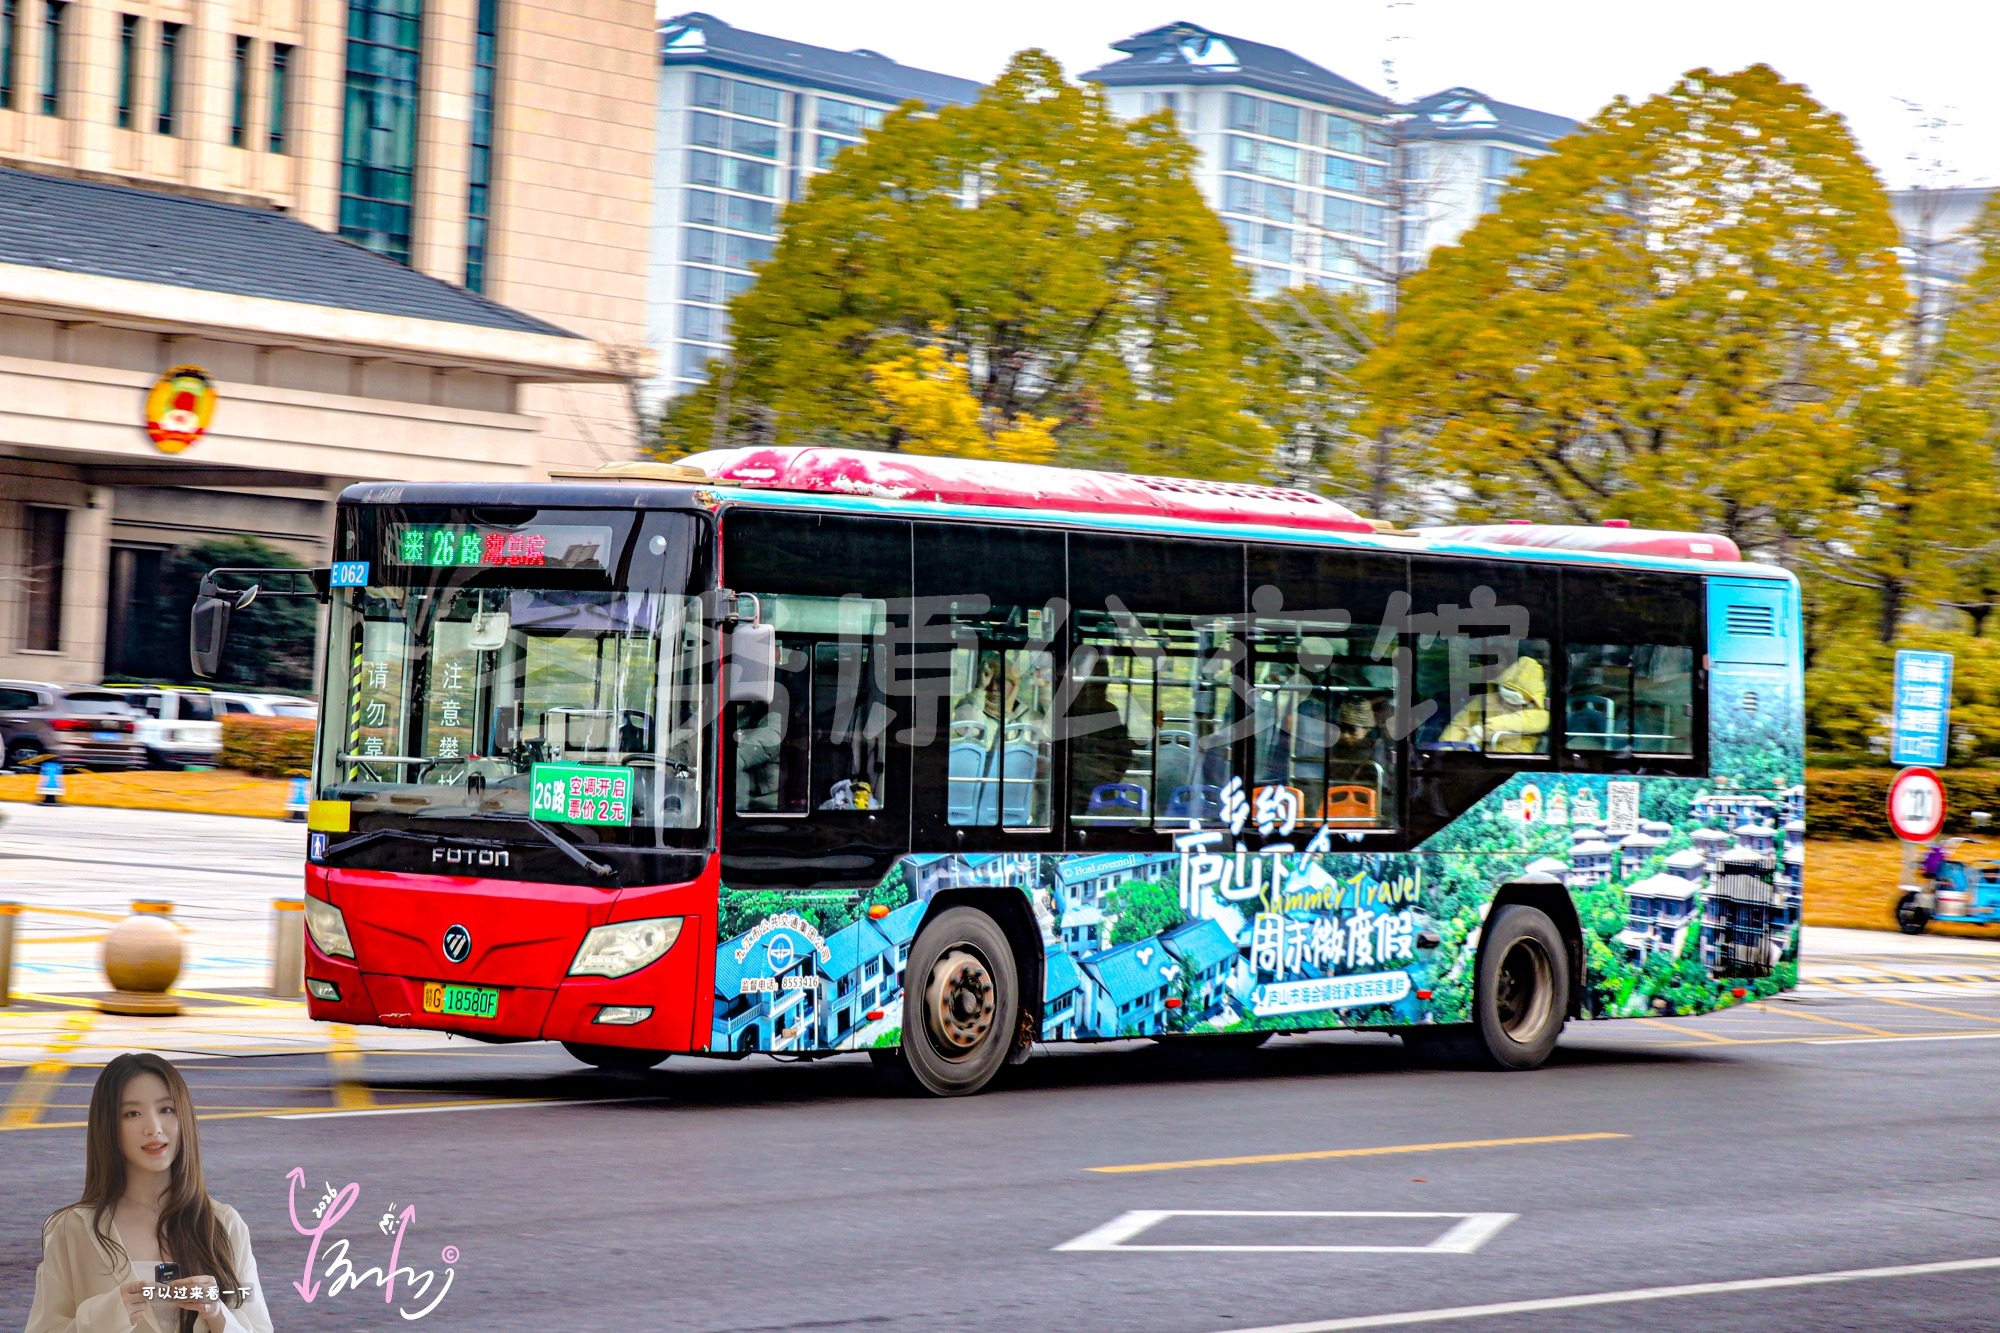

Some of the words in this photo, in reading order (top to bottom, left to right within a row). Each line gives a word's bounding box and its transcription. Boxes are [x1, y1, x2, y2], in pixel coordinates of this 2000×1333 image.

[341, 564, 365, 584] 062
[534, 779, 566, 814] 26路
[569, 775, 626, 799] 空调开启
[568, 798, 626, 822] 票价2元
[432, 847, 510, 867] FOTON
[1257, 881, 1346, 920] Summer
[1347, 866, 1421, 908] Travel
[734, 913, 832, 964] 九江市公共交通集团公司
[1250, 907, 1414, 980] 周末微度假
